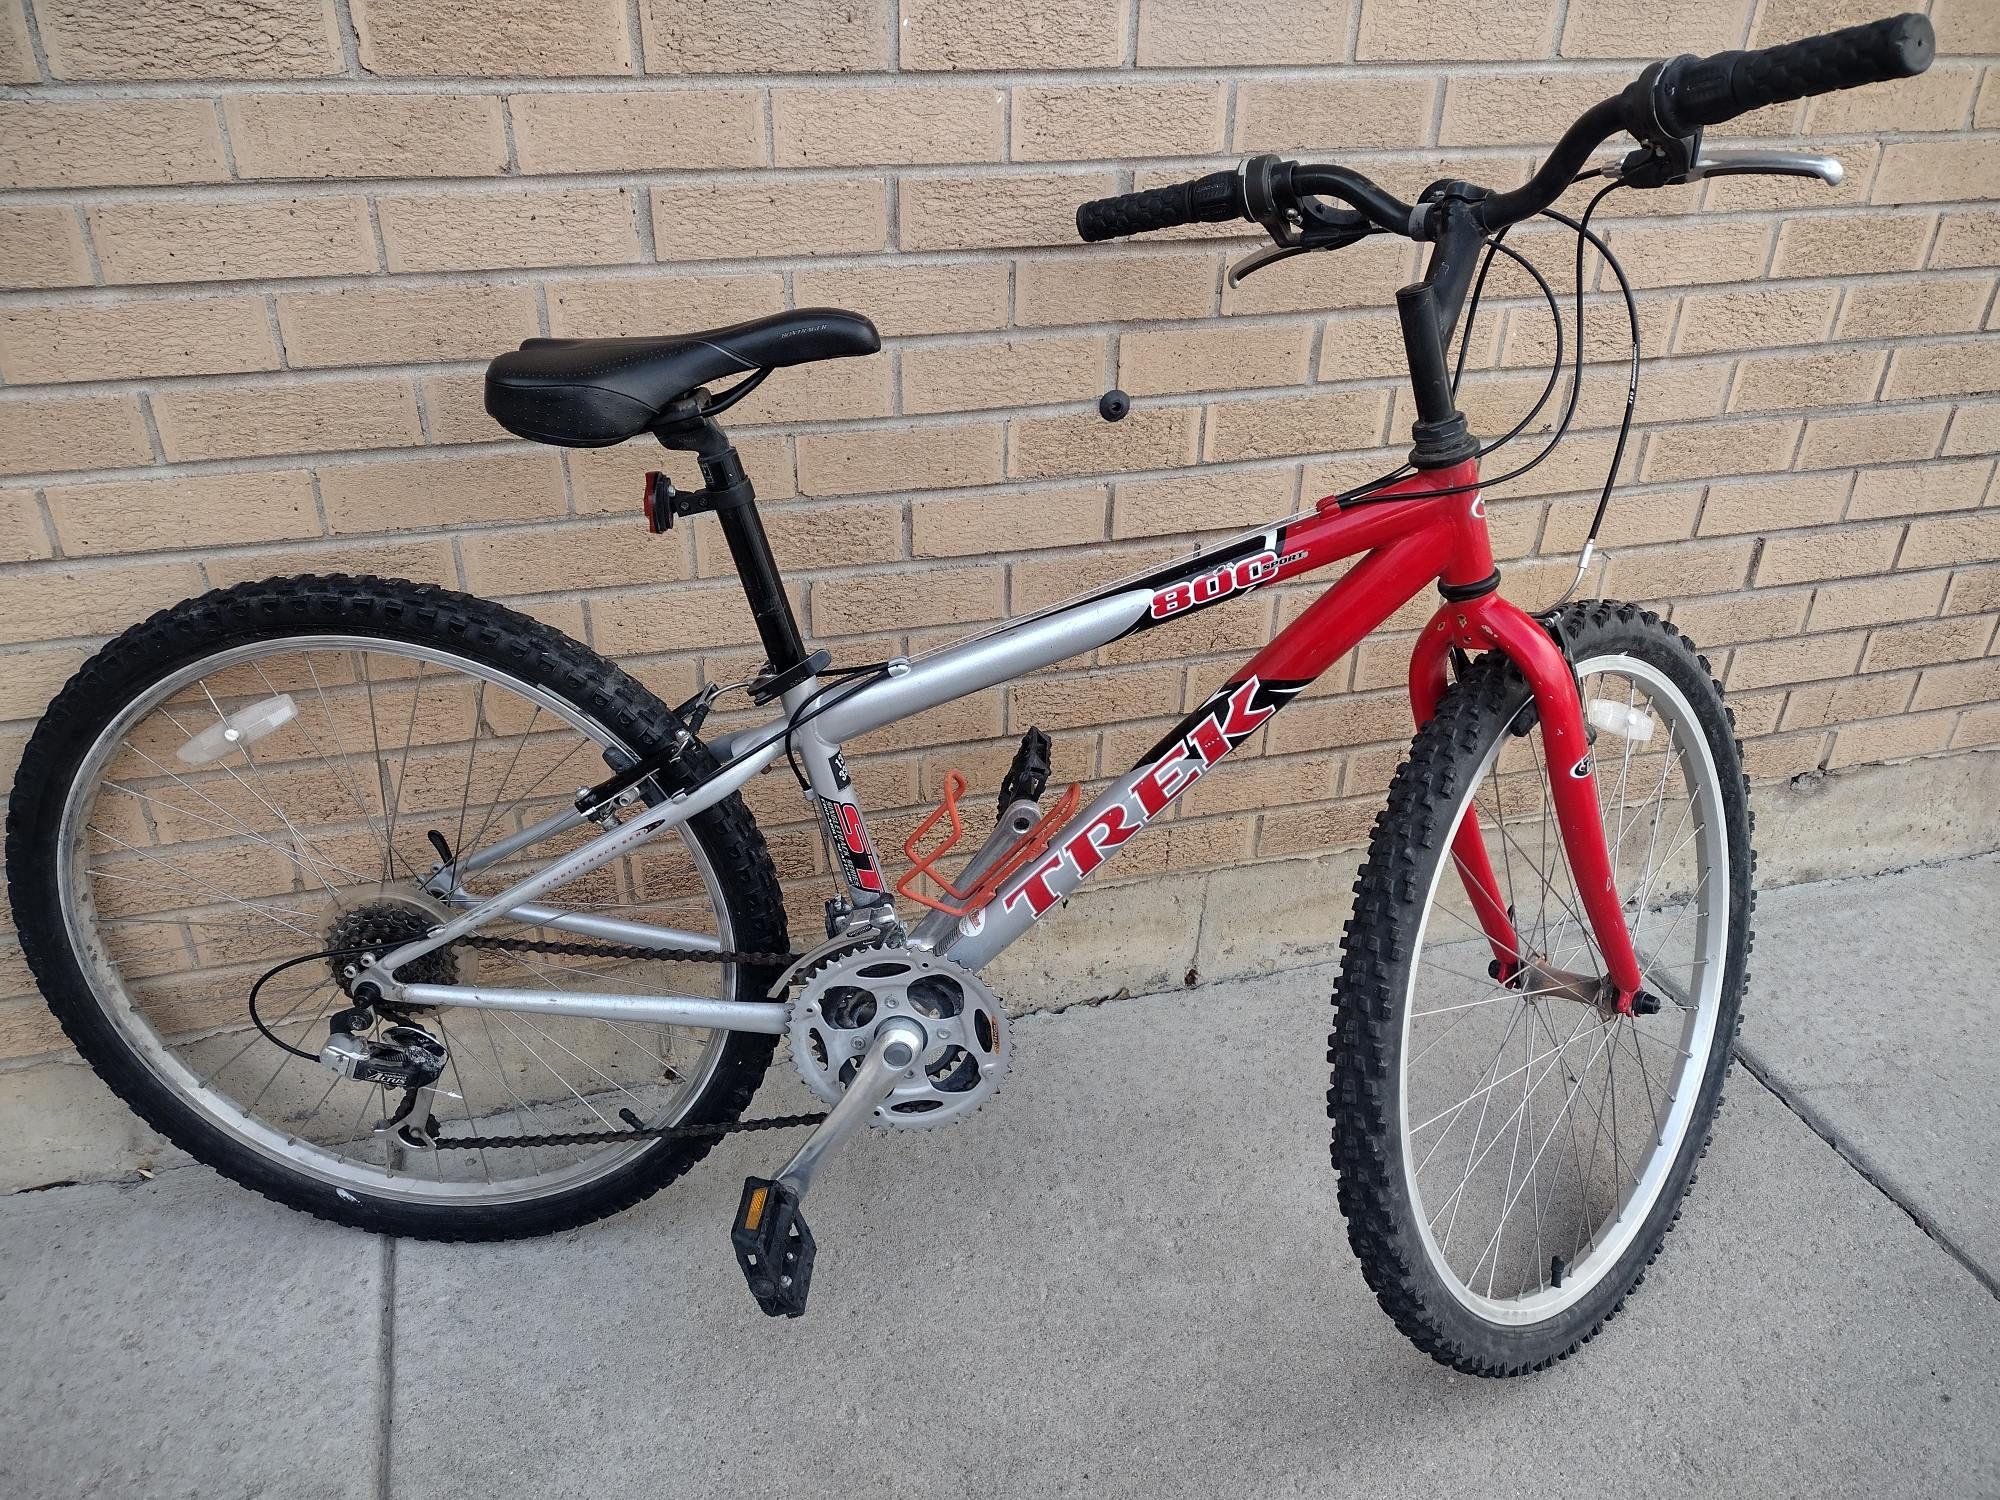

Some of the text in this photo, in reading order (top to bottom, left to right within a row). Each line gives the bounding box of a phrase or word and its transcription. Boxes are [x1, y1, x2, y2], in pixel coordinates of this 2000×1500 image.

[1150, 550, 1307, 619] 800 SPORT
[1002, 674, 1276, 920] TREK
